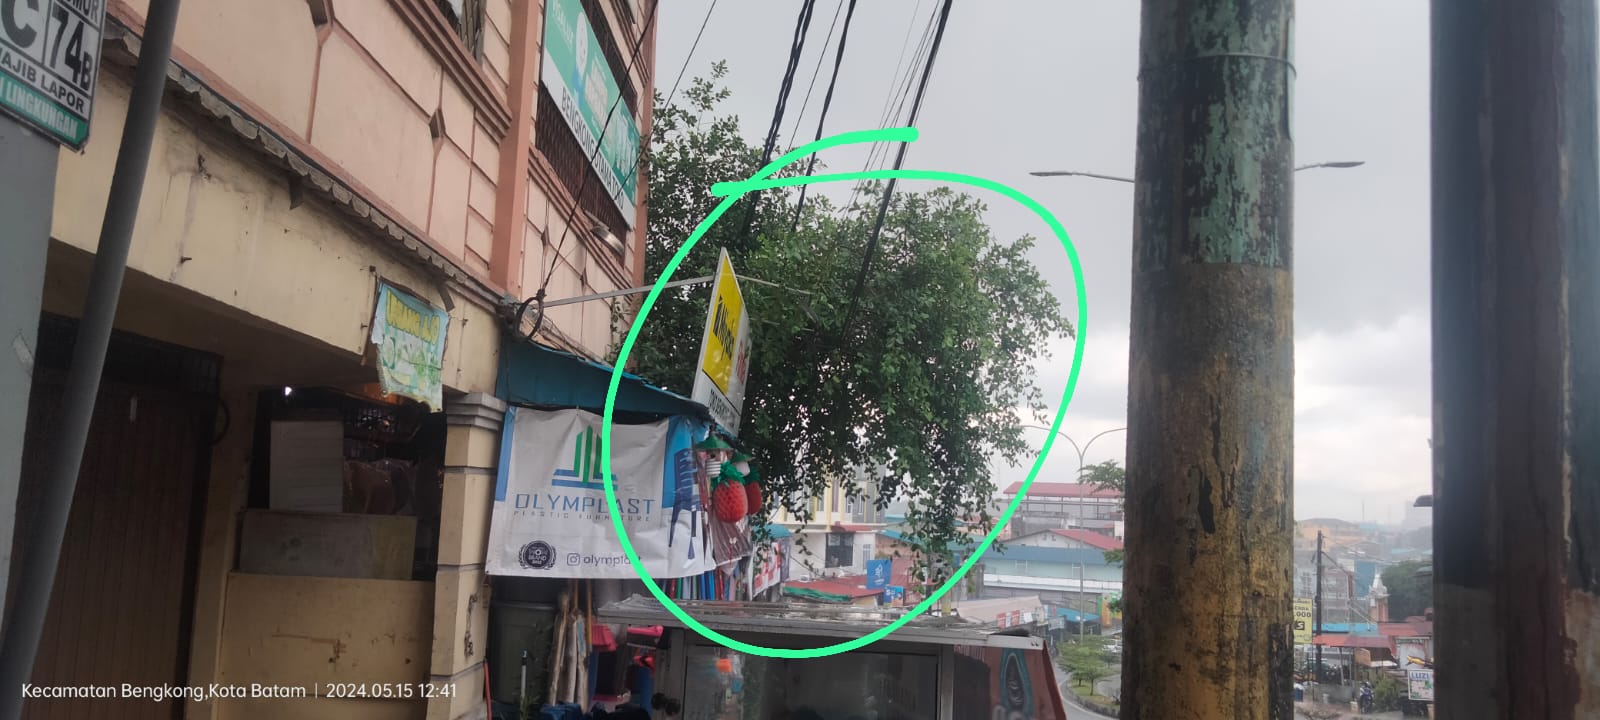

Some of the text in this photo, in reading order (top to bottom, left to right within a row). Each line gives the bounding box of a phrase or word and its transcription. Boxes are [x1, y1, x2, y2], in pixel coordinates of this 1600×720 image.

[0, 0, 39, 48] C
[0, 47, 37, 83] AJIB
[41, 73, 85, 114] LAPOR
[6, 80, 78, 139] LINGKUNGAN
